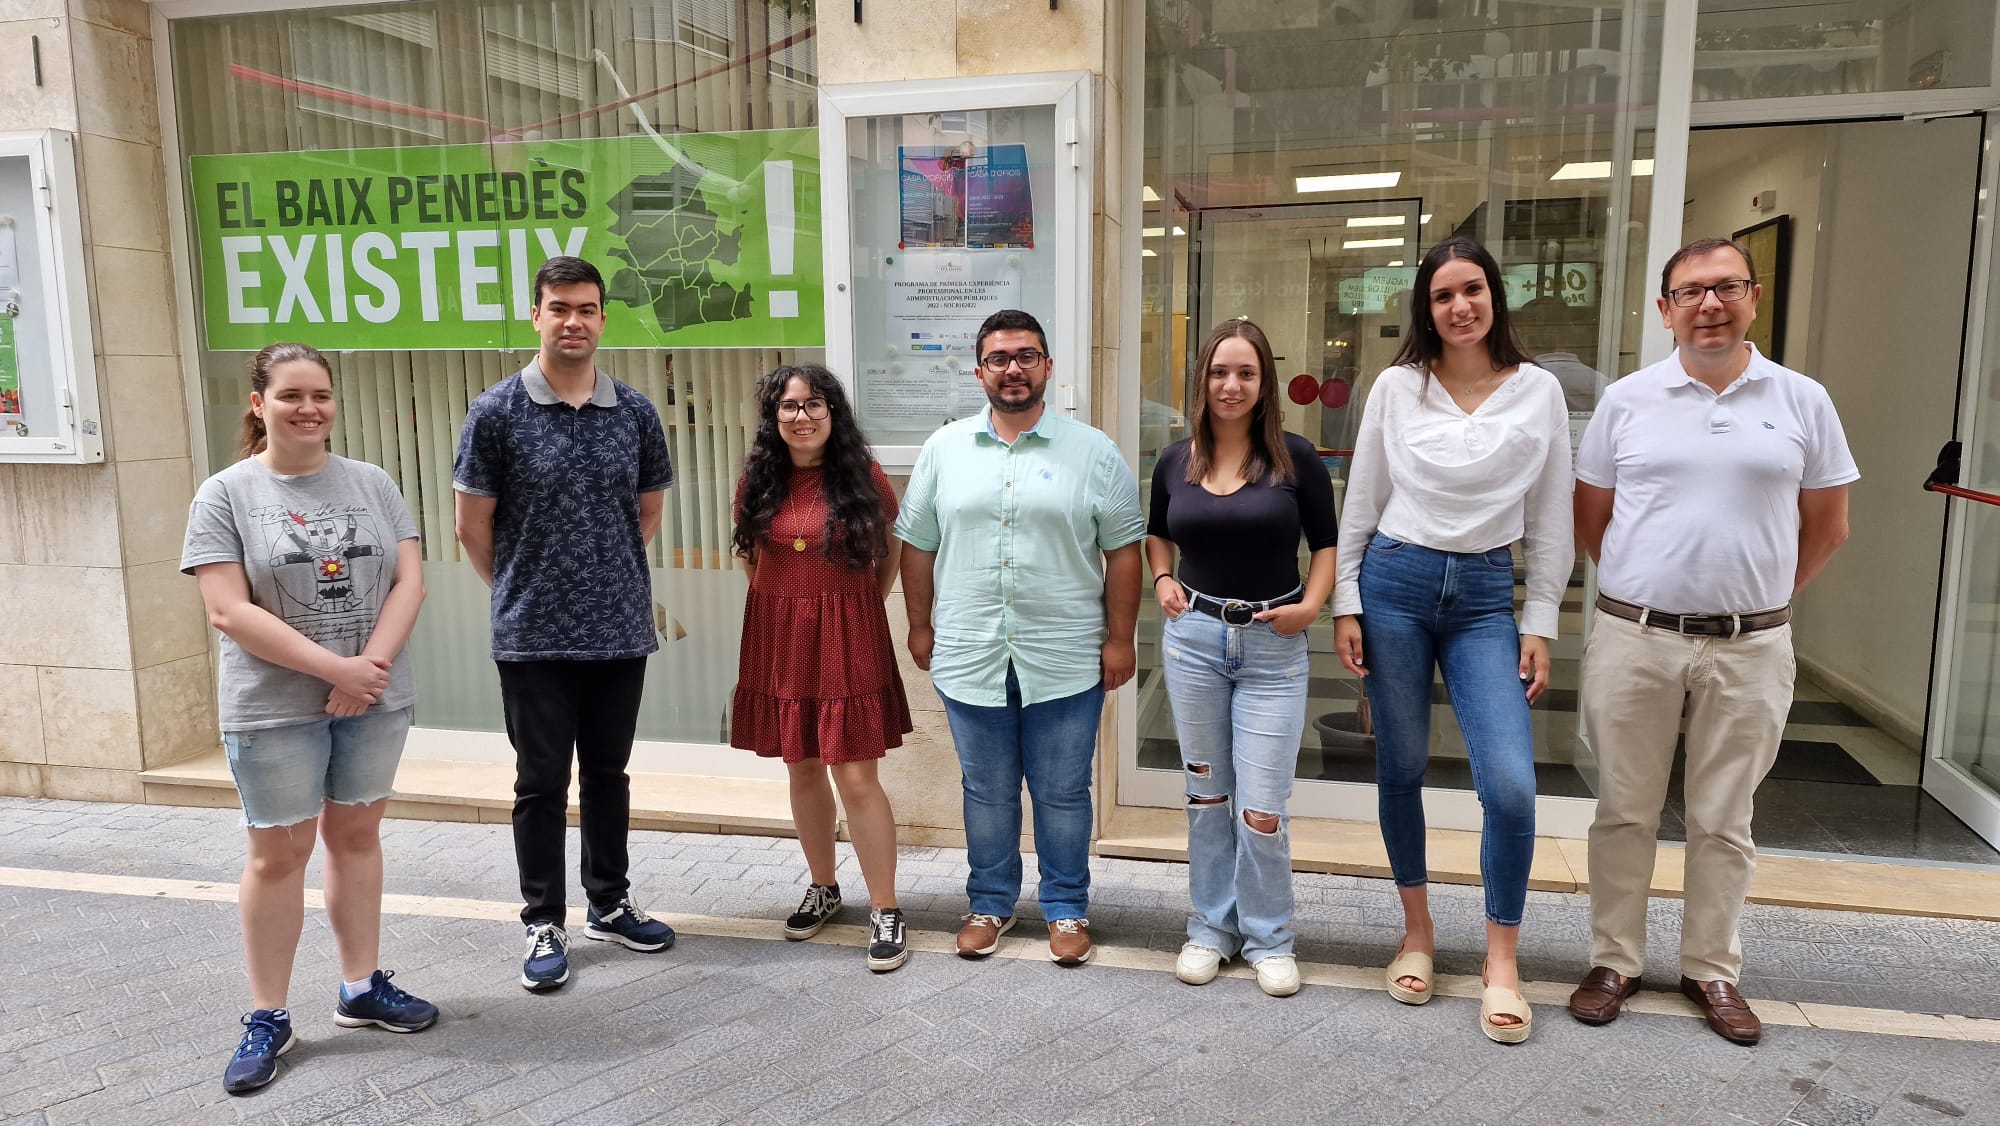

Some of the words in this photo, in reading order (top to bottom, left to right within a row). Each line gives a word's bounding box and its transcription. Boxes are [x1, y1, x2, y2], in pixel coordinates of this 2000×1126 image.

[216, 181, 265, 228] EL
[276, 176, 380, 227] BAIX
[387, 157, 586, 225] PENEDÈS
[764, 160, 799, 318] !
[314, 502, 336, 517] the
[343, 504, 368, 513] sun
